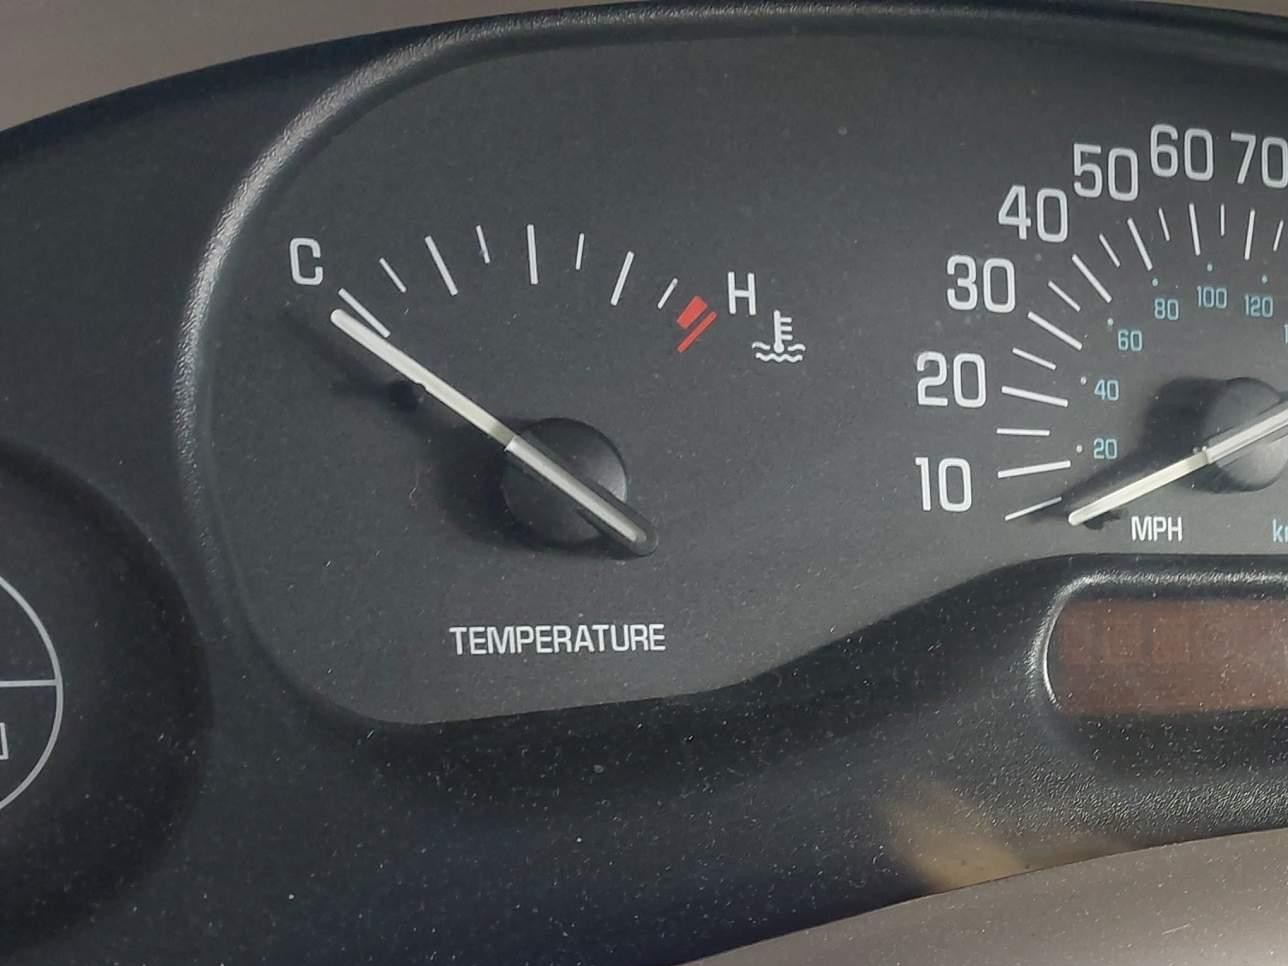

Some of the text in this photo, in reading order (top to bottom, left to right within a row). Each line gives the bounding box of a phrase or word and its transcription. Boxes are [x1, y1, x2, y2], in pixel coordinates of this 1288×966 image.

[1074, 144, 1138, 201] 50
[1151, 125, 1213, 180] 60
[1231, 133, 1288, 188] 70
[999, 186, 1067, 242] 40
[290, 238, 323, 285] C
[728, 272, 756, 315] H
[948, 255, 1015, 312] 30
[1197, 286, 1227, 308] 100k
[1155, 299, 1178, 320] 80k
[1245, 295, 1273, 317] 120k
[1118, 330, 1142, 351] 60k
[917, 352, 986, 407] 20
[1095, 380, 1118, 400] 40k
[1094, 438, 1117, 458] 20k
[916, 458, 971, 511] 10
[1132, 516, 1182, 541] MPH
[450, 624, 665, 654] TEMPERATURE
